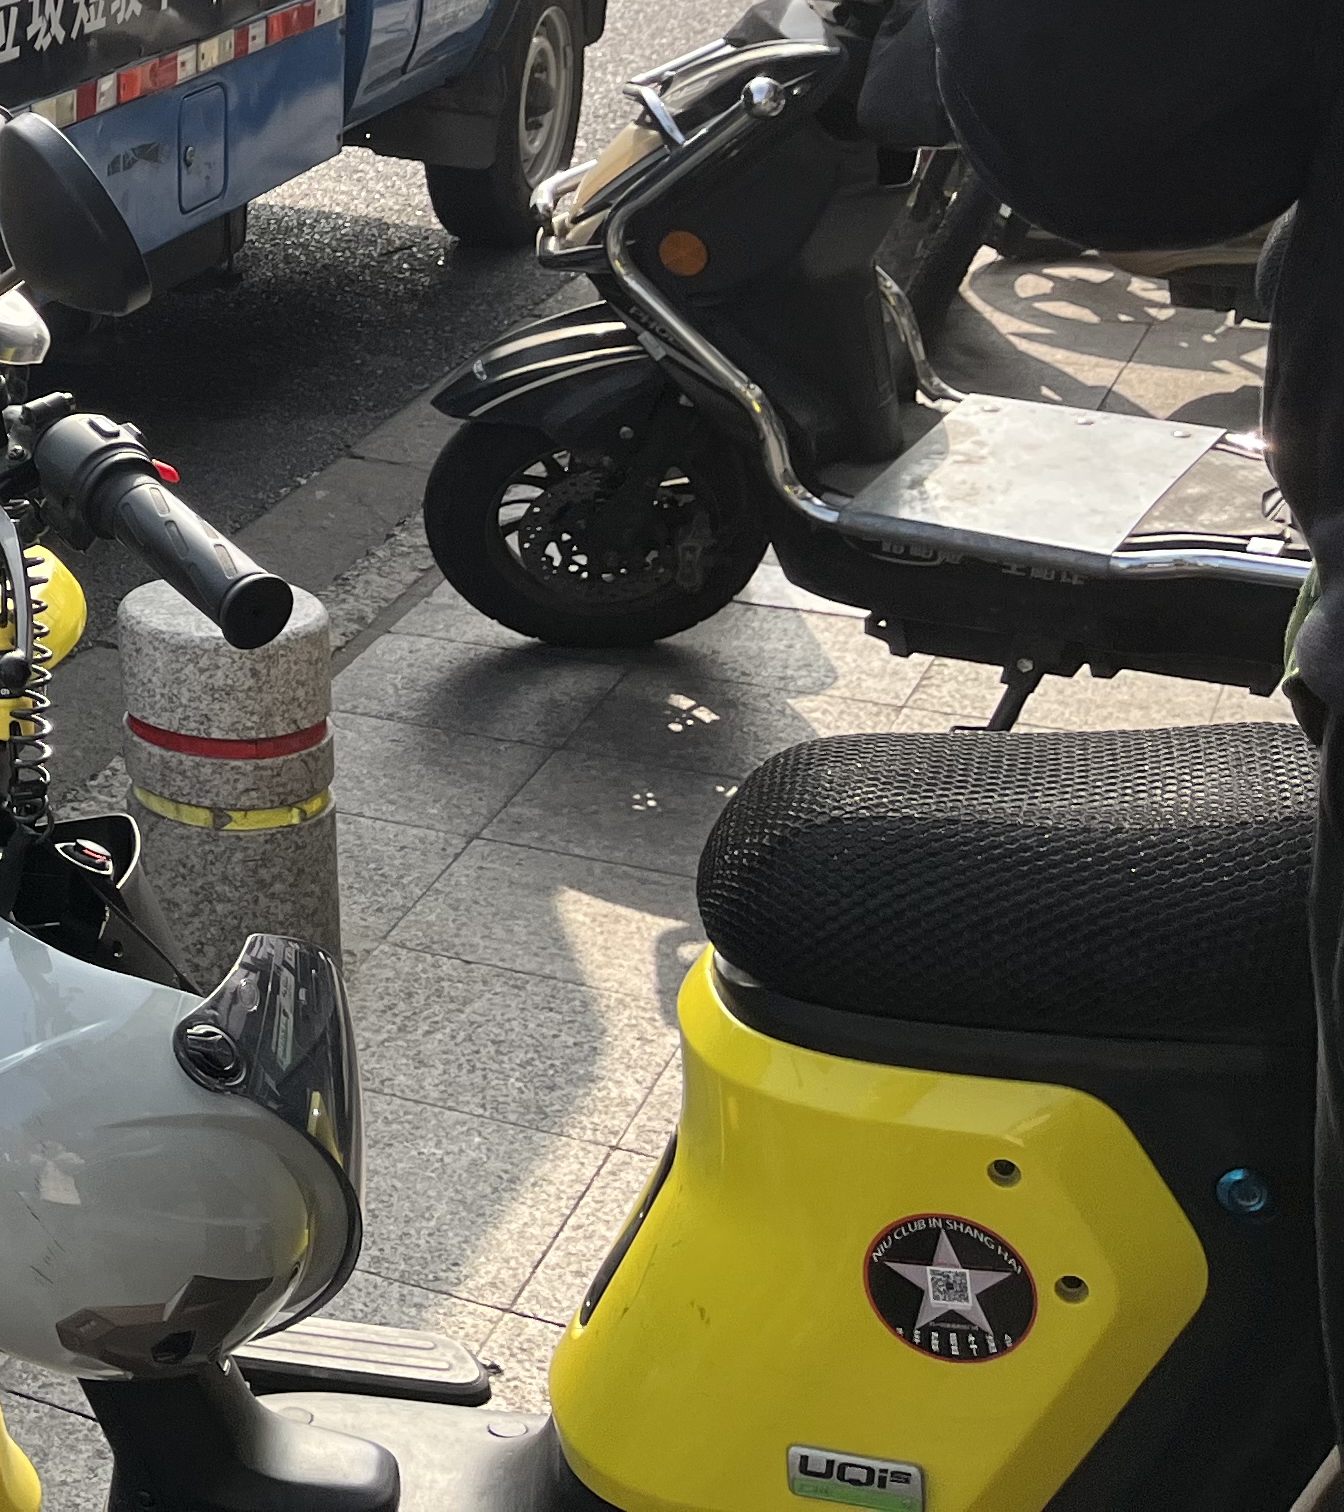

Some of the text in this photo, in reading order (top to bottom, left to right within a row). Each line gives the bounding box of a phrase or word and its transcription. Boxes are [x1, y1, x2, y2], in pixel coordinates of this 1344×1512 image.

[870, 1236, 893, 1262] NIU
[894, 1219, 927, 1241] CLUB
[928, 1217, 943, 1229] IN
